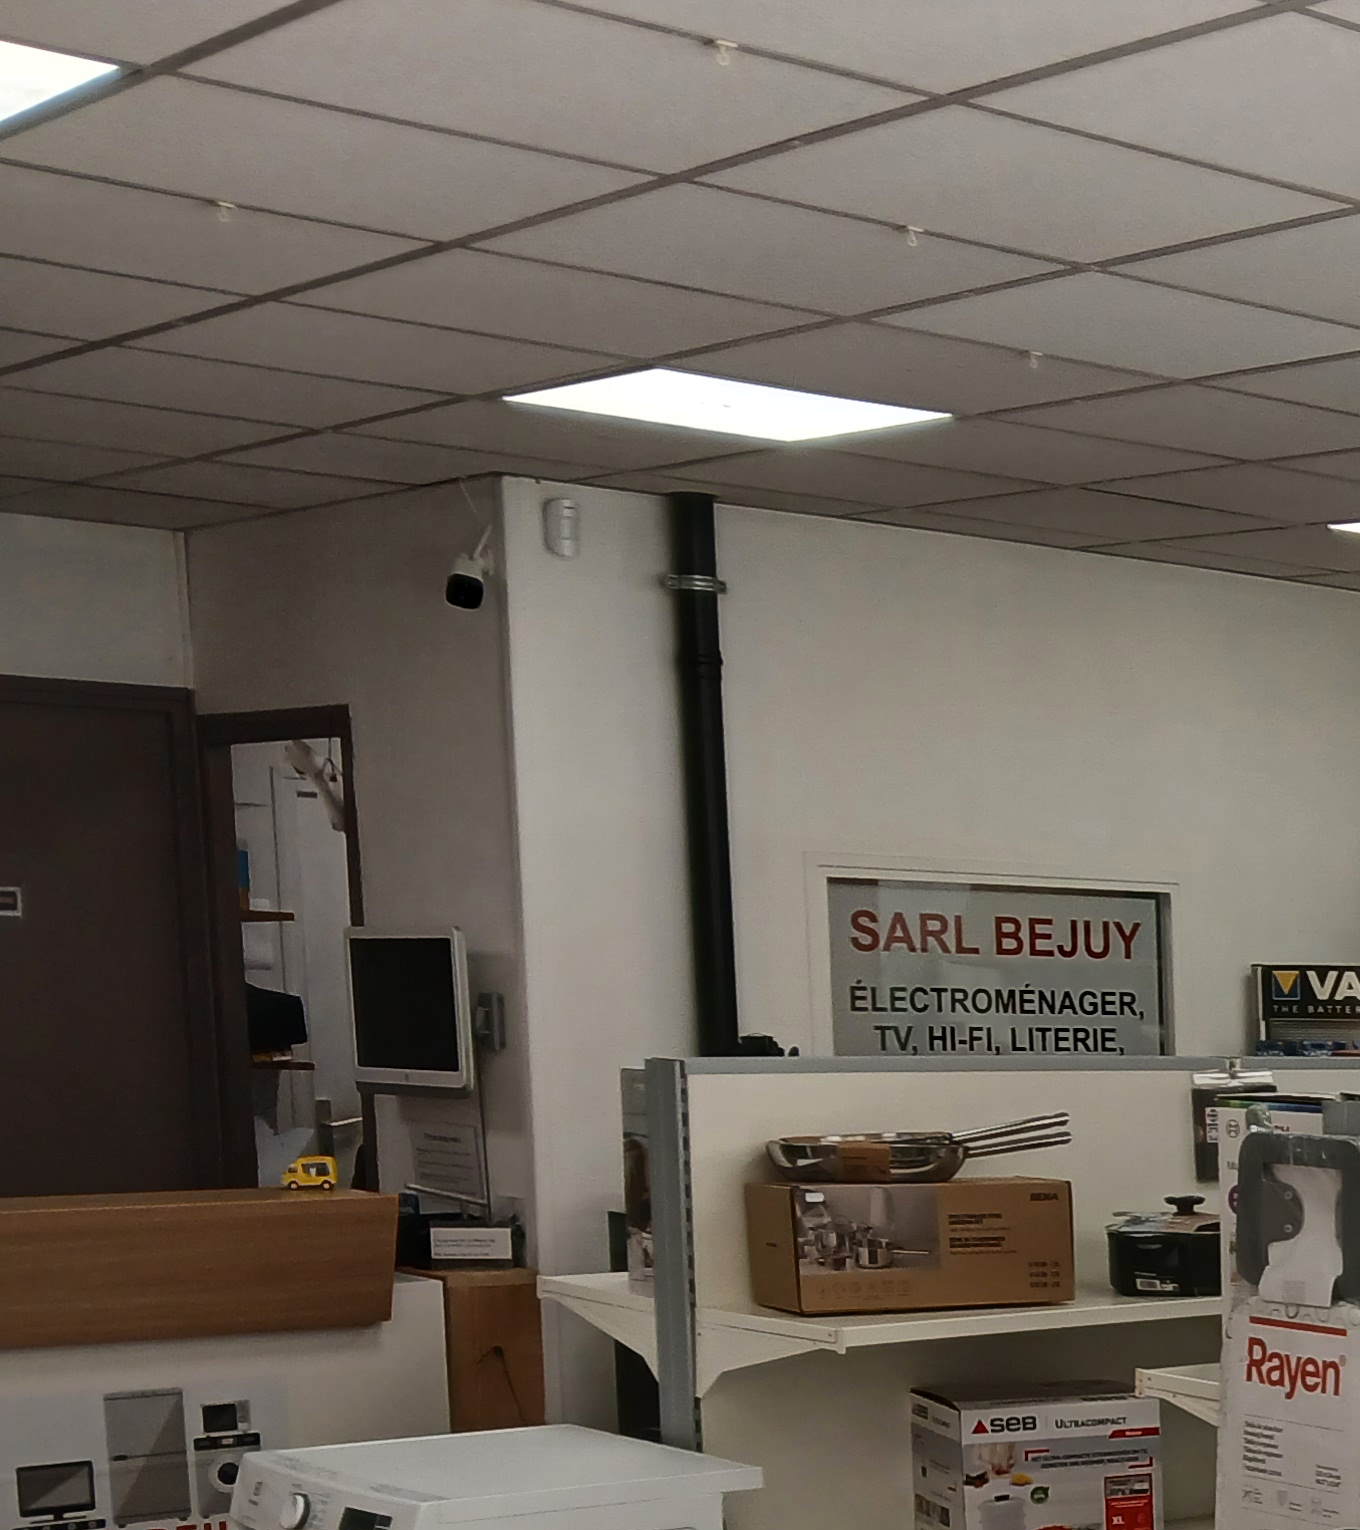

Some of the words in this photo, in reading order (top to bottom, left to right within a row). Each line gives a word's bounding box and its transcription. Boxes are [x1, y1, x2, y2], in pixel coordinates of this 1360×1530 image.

[851, 909, 980, 955] SARL
[994, 915, 1141, 960] BEJUY
[850, 979, 1145, 1021] ÉLECTROMÉNAGER,
[1273, 1004, 1299, 1014] THE
[874, 1025, 919, 1056] TV,
[928, 1026, 1001, 1056] HI-FI,
[1010, 1027, 1126, 1056] LITERIE,
[1246, 1336, 1342, 1401] Rayen
